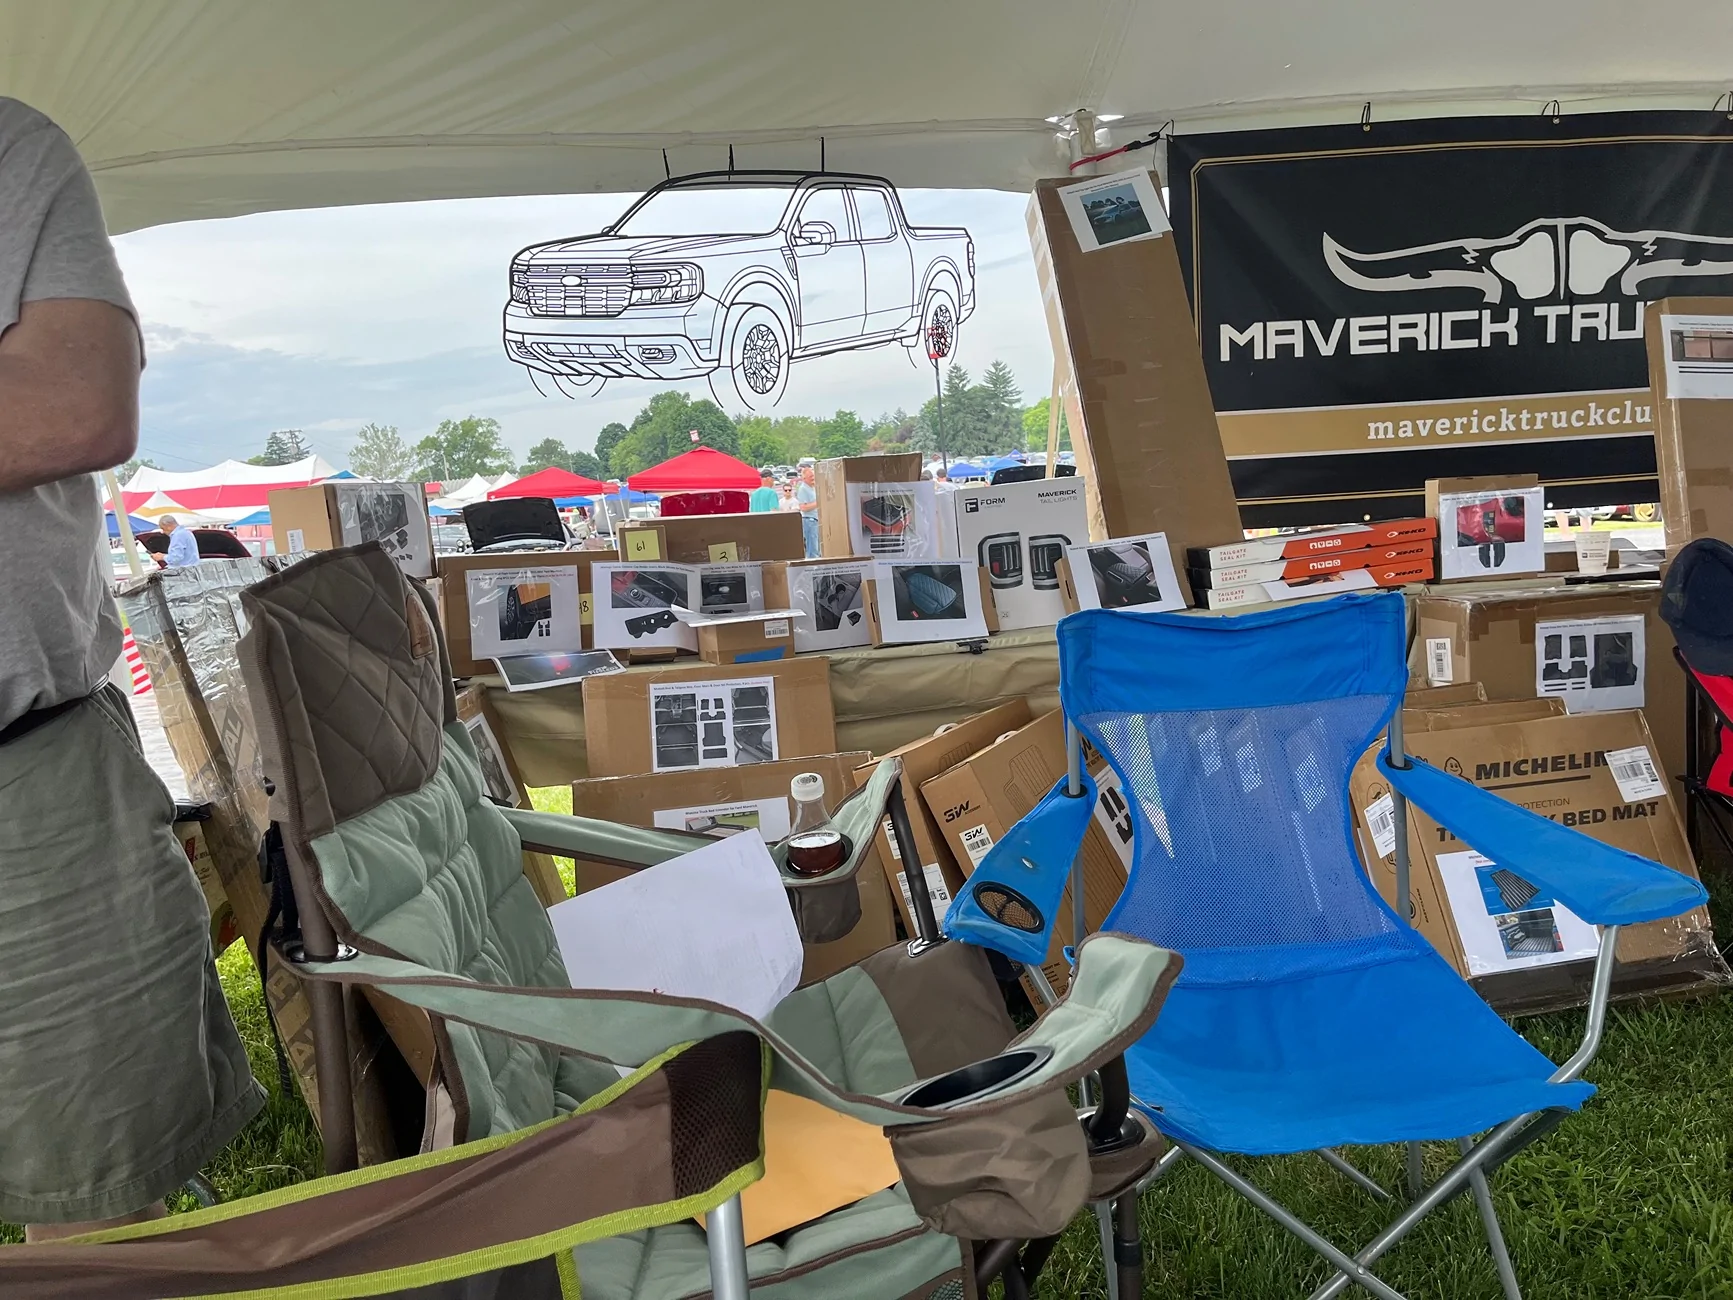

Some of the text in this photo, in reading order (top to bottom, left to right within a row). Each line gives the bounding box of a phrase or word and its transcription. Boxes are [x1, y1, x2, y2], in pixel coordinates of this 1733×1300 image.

[1219, 301, 1649, 362] MAVERICK TRU
[1367, 401, 1651, 440] mavericktruckclu
[980, 497, 1006, 506] FORM
[1037, 489, 1077, 498] MAVERICK
[636, 540, 646, 552] 61
[1220, 548, 1247, 556] TAILGATE
[1475, 750, 1613, 781] MICHELIN
[1562, 802, 1659, 827] BED MAT
